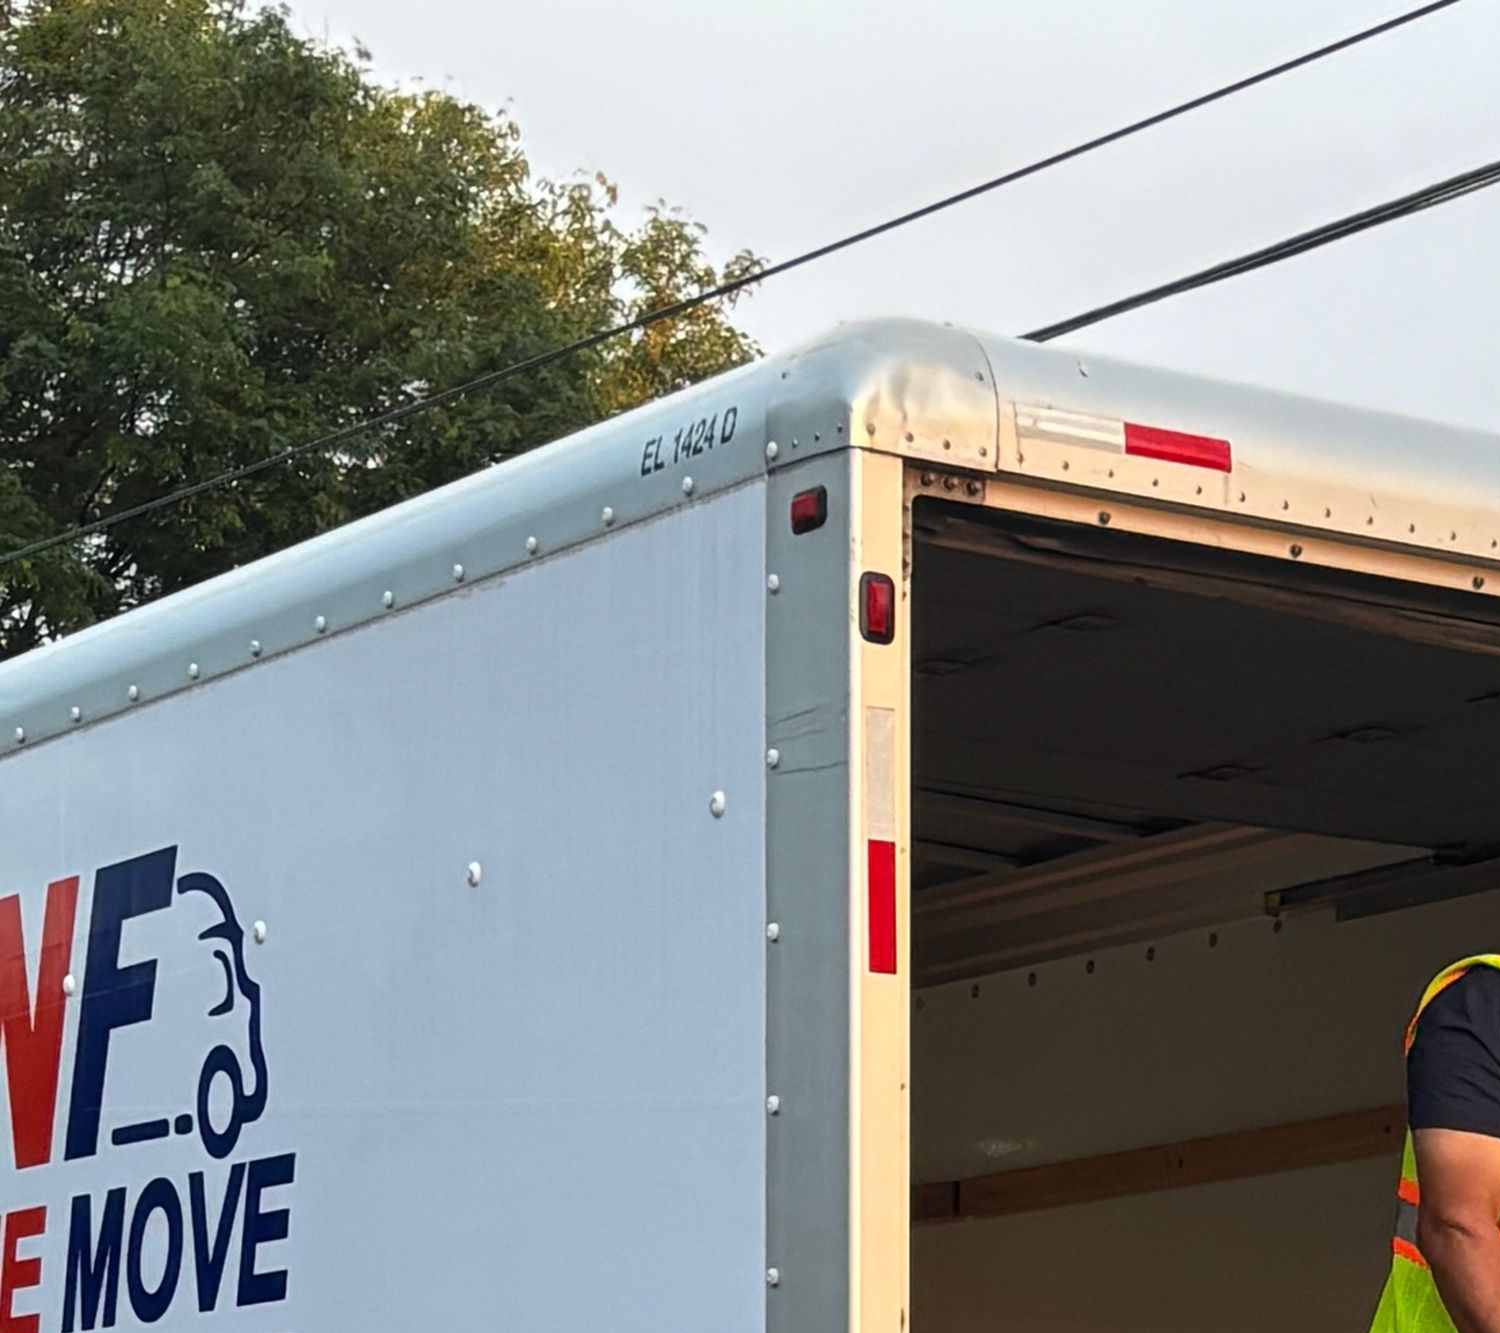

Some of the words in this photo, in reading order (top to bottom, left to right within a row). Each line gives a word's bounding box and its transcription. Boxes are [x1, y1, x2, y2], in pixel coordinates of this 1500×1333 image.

[640, 435, 665, 476] EL
[673, 413, 717, 464] 1424
[720, 406, 738, 445] D
